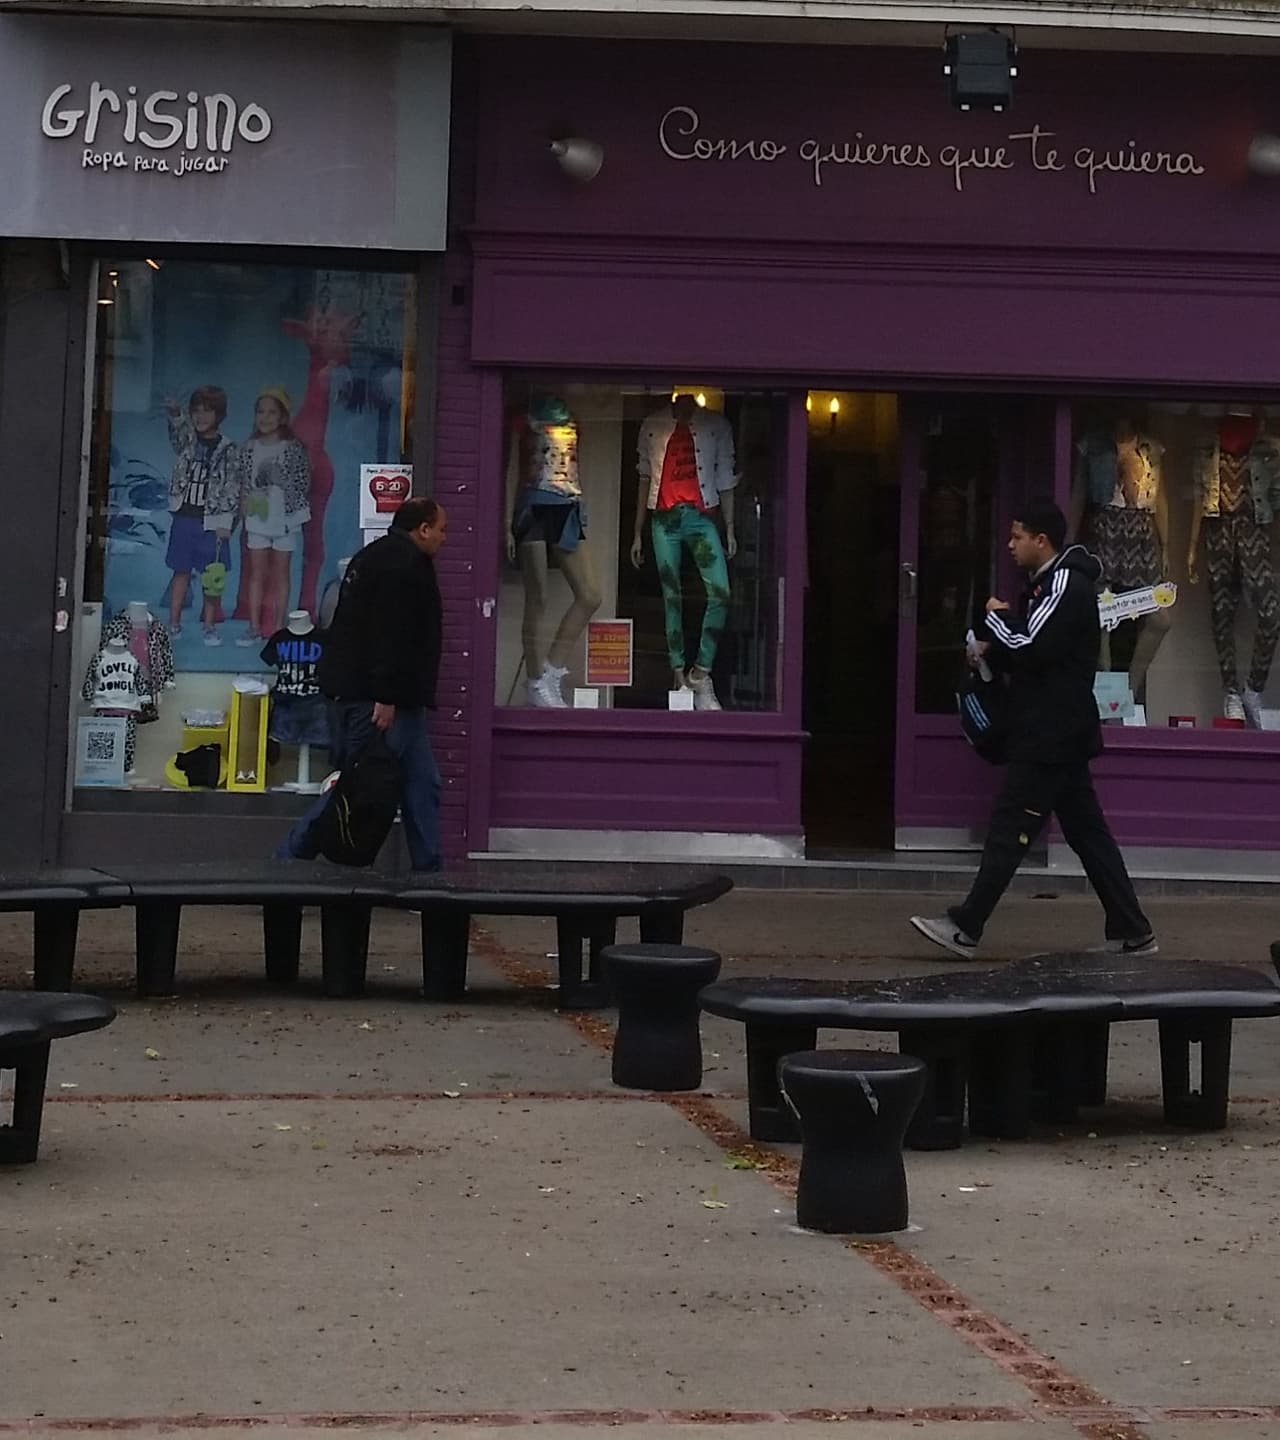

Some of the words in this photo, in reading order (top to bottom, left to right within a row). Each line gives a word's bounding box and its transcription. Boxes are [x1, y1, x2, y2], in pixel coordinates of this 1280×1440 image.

[42, 81, 271, 152] Grisino
[82, 149, 127, 172] Ropa
[134, 155, 169, 172] para
[174, 151, 228, 176] jugar
[659, 106, 787, 160] Como
[799, 132, 931, 186] quieres
[939, 145, 1014, 191] que
[1074, 141, 1205, 193] quiera
[276, 640, 322, 662] WILD
